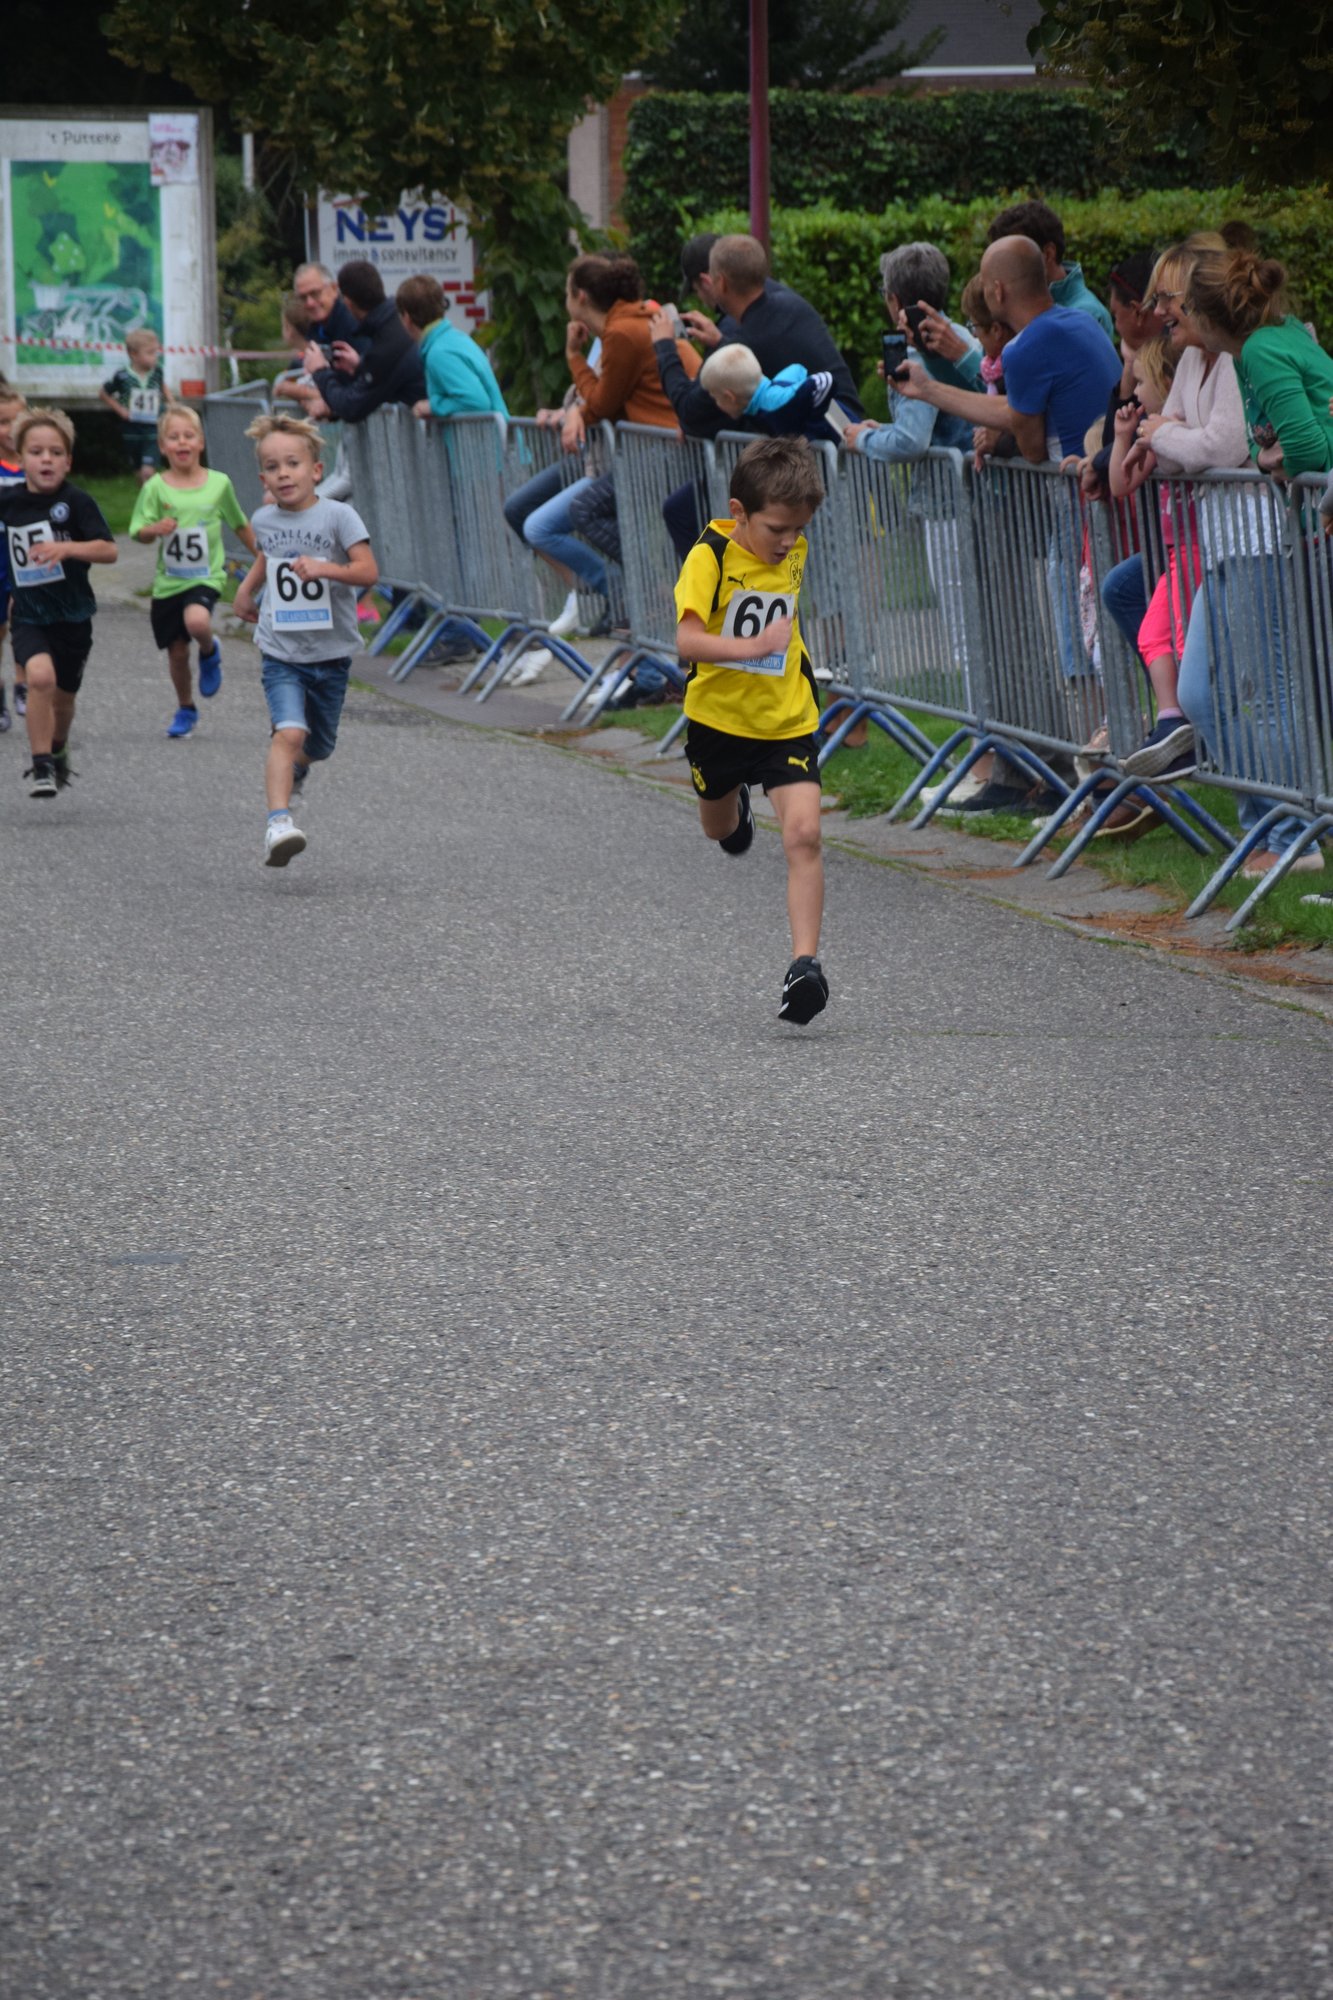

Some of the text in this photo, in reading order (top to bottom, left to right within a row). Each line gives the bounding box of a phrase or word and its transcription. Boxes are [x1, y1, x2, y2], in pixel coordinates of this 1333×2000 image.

[336, 207, 447, 241] NEYS
[333, 247, 369, 262] immo
[381, 247, 458, 263] consultancy
[134, 394, 155, 411] 41
[166, 533, 204, 562] 45
[276, 562, 324, 602] 68
[733, 595, 788, 639] 60
